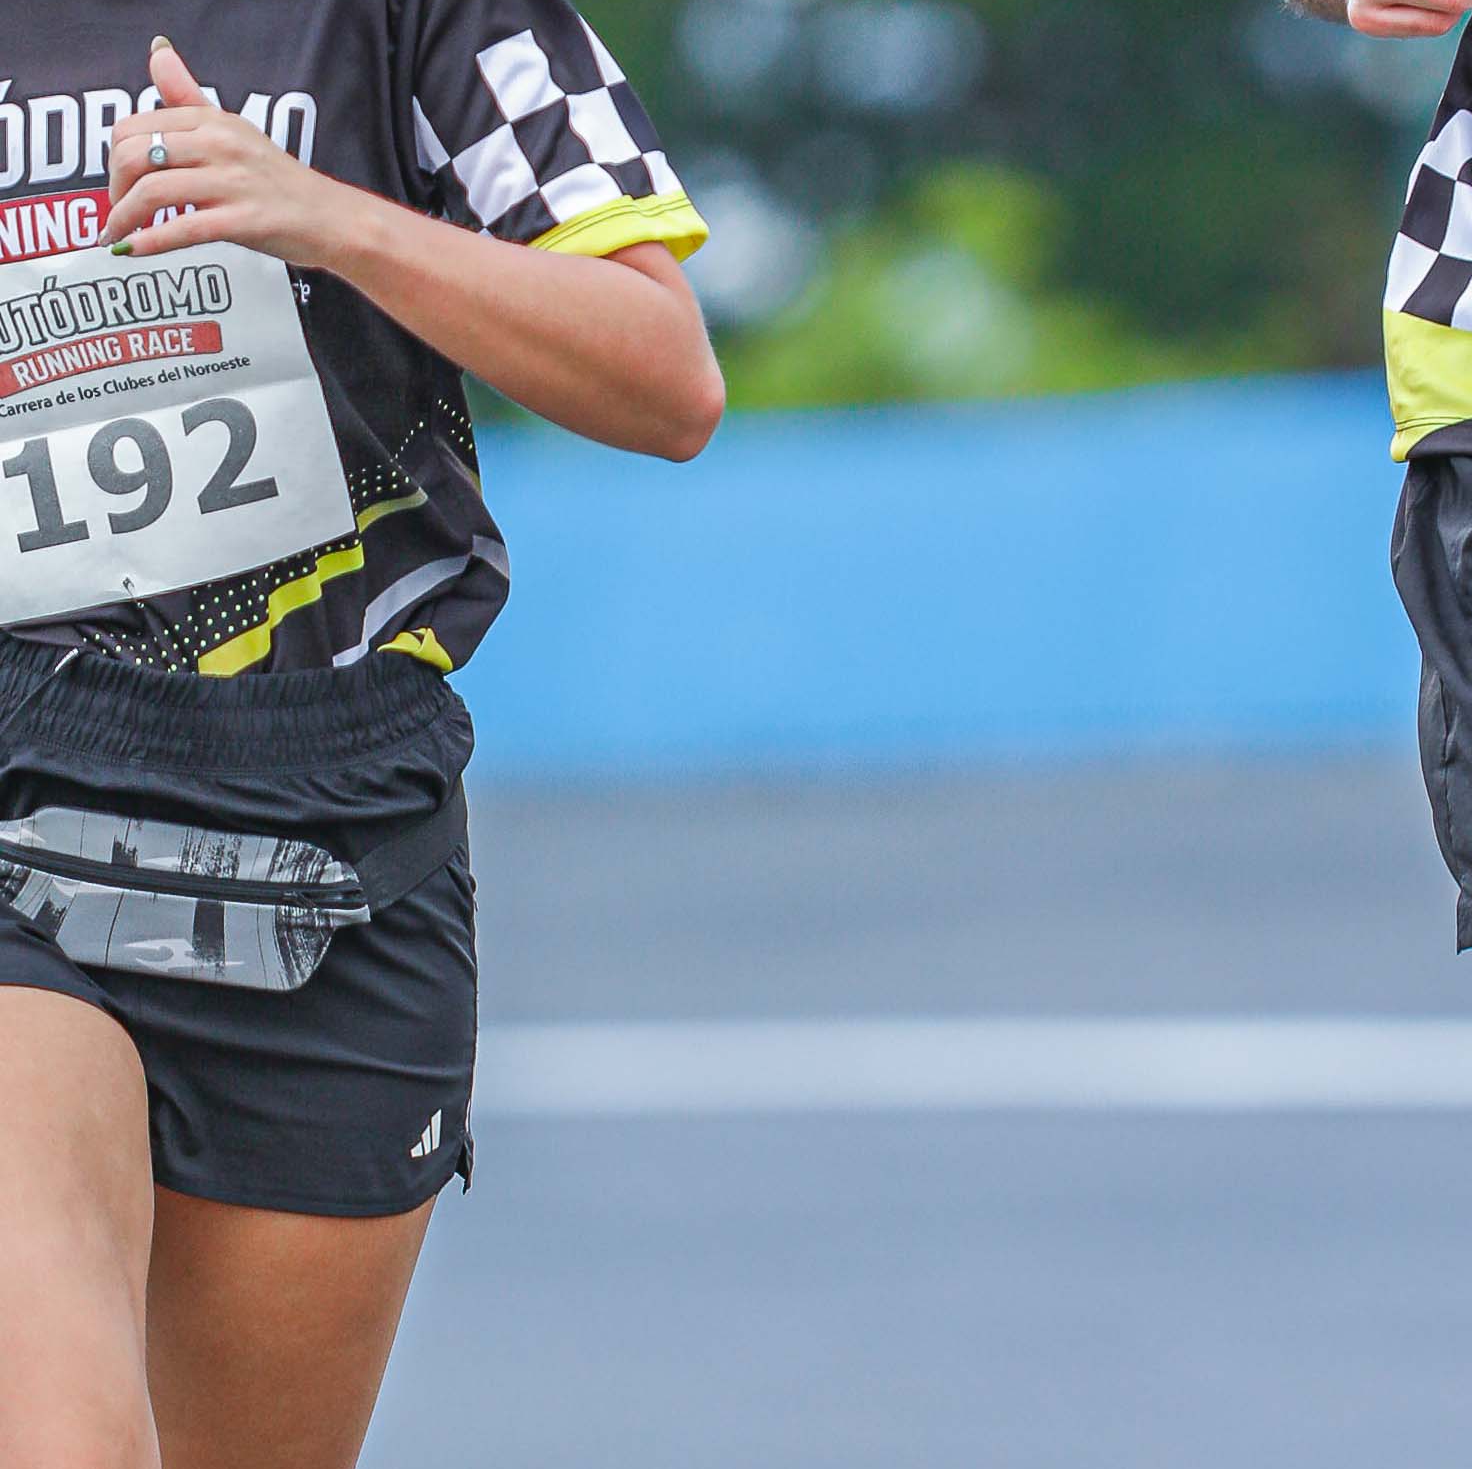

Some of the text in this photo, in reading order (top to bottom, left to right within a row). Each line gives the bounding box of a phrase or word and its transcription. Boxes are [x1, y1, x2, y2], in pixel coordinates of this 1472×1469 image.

[0, 355, 251, 418] Carrera de los Clubes del Noroeste
[11, 327, 196, 388] RUNNING RACE
[2, 396, 279, 553] 192
